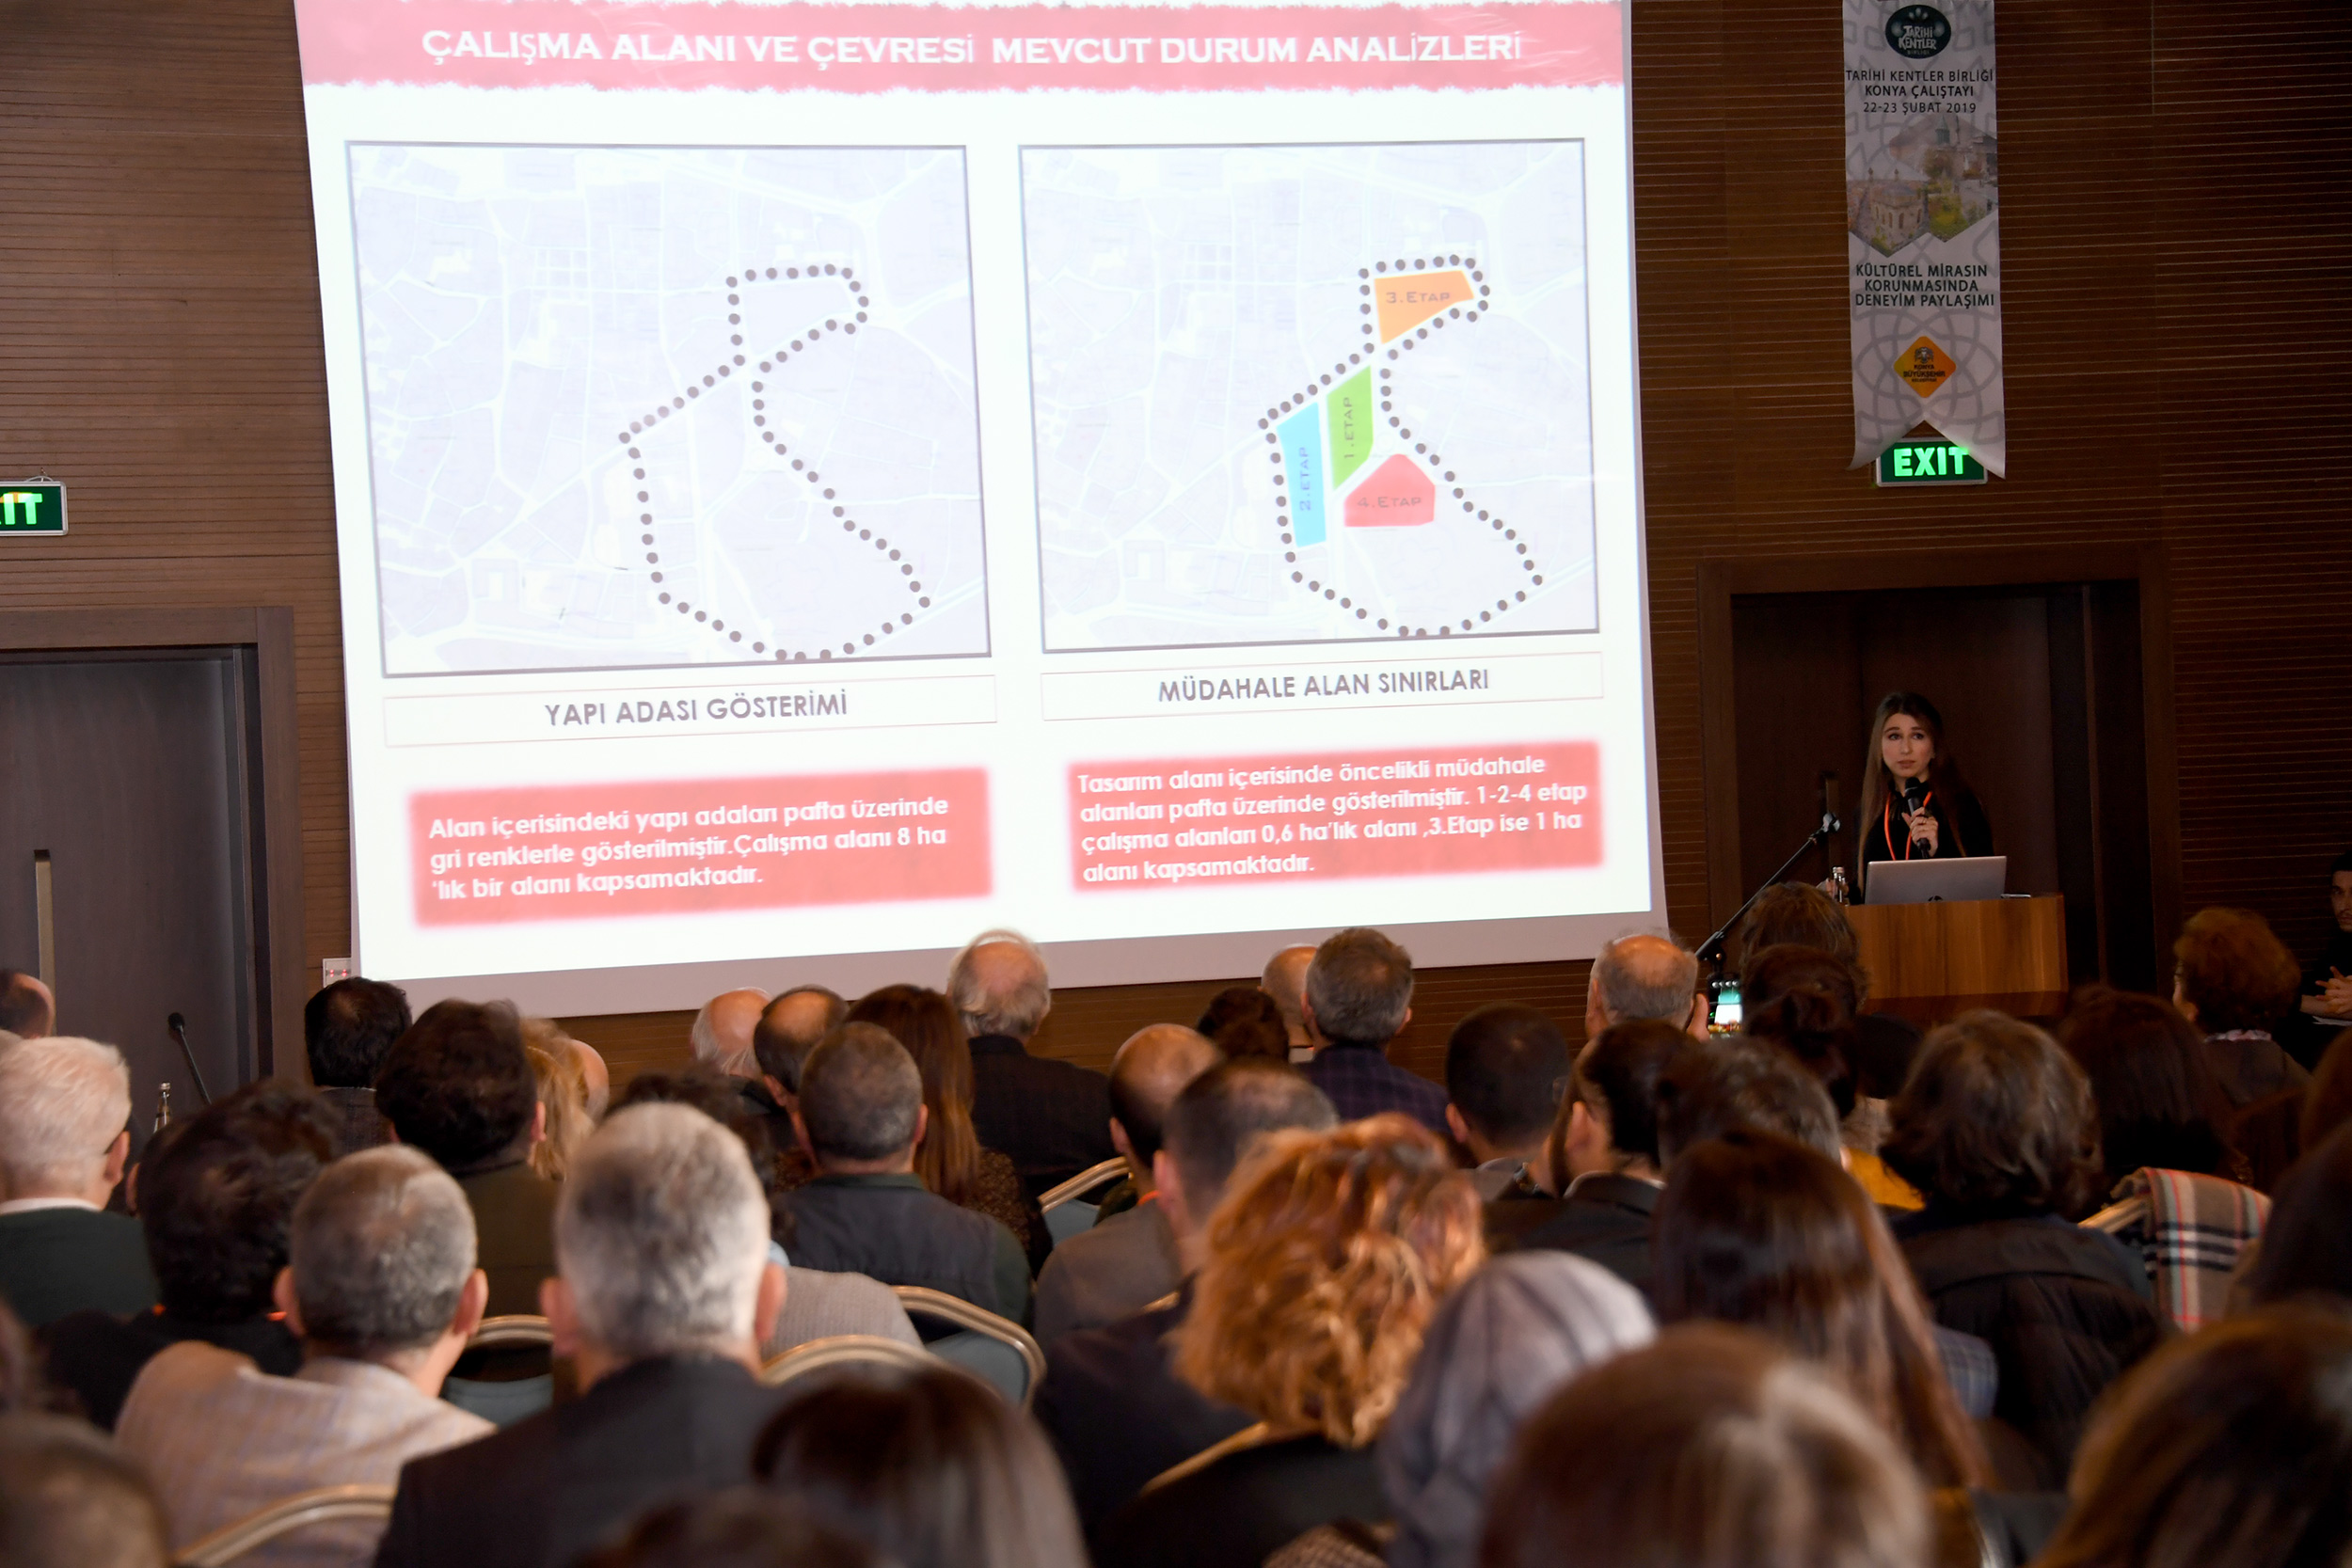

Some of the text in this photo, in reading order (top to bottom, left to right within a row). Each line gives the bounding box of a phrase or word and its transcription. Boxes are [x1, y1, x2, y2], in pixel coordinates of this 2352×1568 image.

[421, 30, 603, 65] ÇALIŞMA
[611, 33, 737, 62] ALANI
[744, 36, 800, 63] VE
[993, 38, 1152, 64] MEVCUT
[1160, 36, 1297, 64] DURUM
[1306, 31, 1521, 64] ANALİZLERİ
[1898, 37, 1938, 51] KENTLER
[1846, 69, 1994, 82] TARİHİ KENTLER BİRLİĞİ
[1863, 102, 1977, 116] 22-23 ŞUBAT 2019
[1865, 85, 1974, 100] KONYA ÇALIŞTAYI
[1855, 262, 1988, 277] KÜLTÜREL MİRASIN
[1865, 279, 1979, 293] KORUNMASINDA
[1855, 293, 1994, 309] DENEYİM PAYLAŞIMI
[1893, 446, 1969, 477] EXIT
[0, 492, 43, 525] IT
[1158, 669, 1489, 702] MÜDAHALE ALAN SINIRLARI
[545, 689, 848, 726] YAPI ADASI GÖSTERİMİ
[1077, 756, 1546, 793] Tasarım alanı içerisinde öncelikli müdahale
[429, 817, 485, 839] Alan
[491, 810, 630, 840] içerisindeki
[635, 810, 689, 834] yapı
[783, 800, 846, 828] pafta
[850, 796, 949, 819] üzerinde
[1168, 799, 1227, 824] pafta
[1232, 794, 1326, 816] üzerinde
[1476, 784, 1532, 804] 1-2-4
[1536, 783, 1588, 806] etap
[1081, 832, 1169, 856] çalışma
[1261, 824, 1294, 846] 0,6
[1363, 820, 1418, 840] alanı
[1499, 814, 1530, 832] ise
[1535, 812, 1546, 830] 1
[1552, 812, 1582, 831] ha
[430, 849, 462, 876] gri
[468, 845, 575, 868] renklerle
[834, 829, 892, 849] alanı
[897, 827, 911, 847] 8
[916, 826, 946, 845] ha
[472, 877, 504, 897] bir
[511, 875, 571, 895] alanı
[577, 864, 764, 896] kapsamaktadır.
[1083, 853, 1315, 883] alanı kapsamaktadır.
